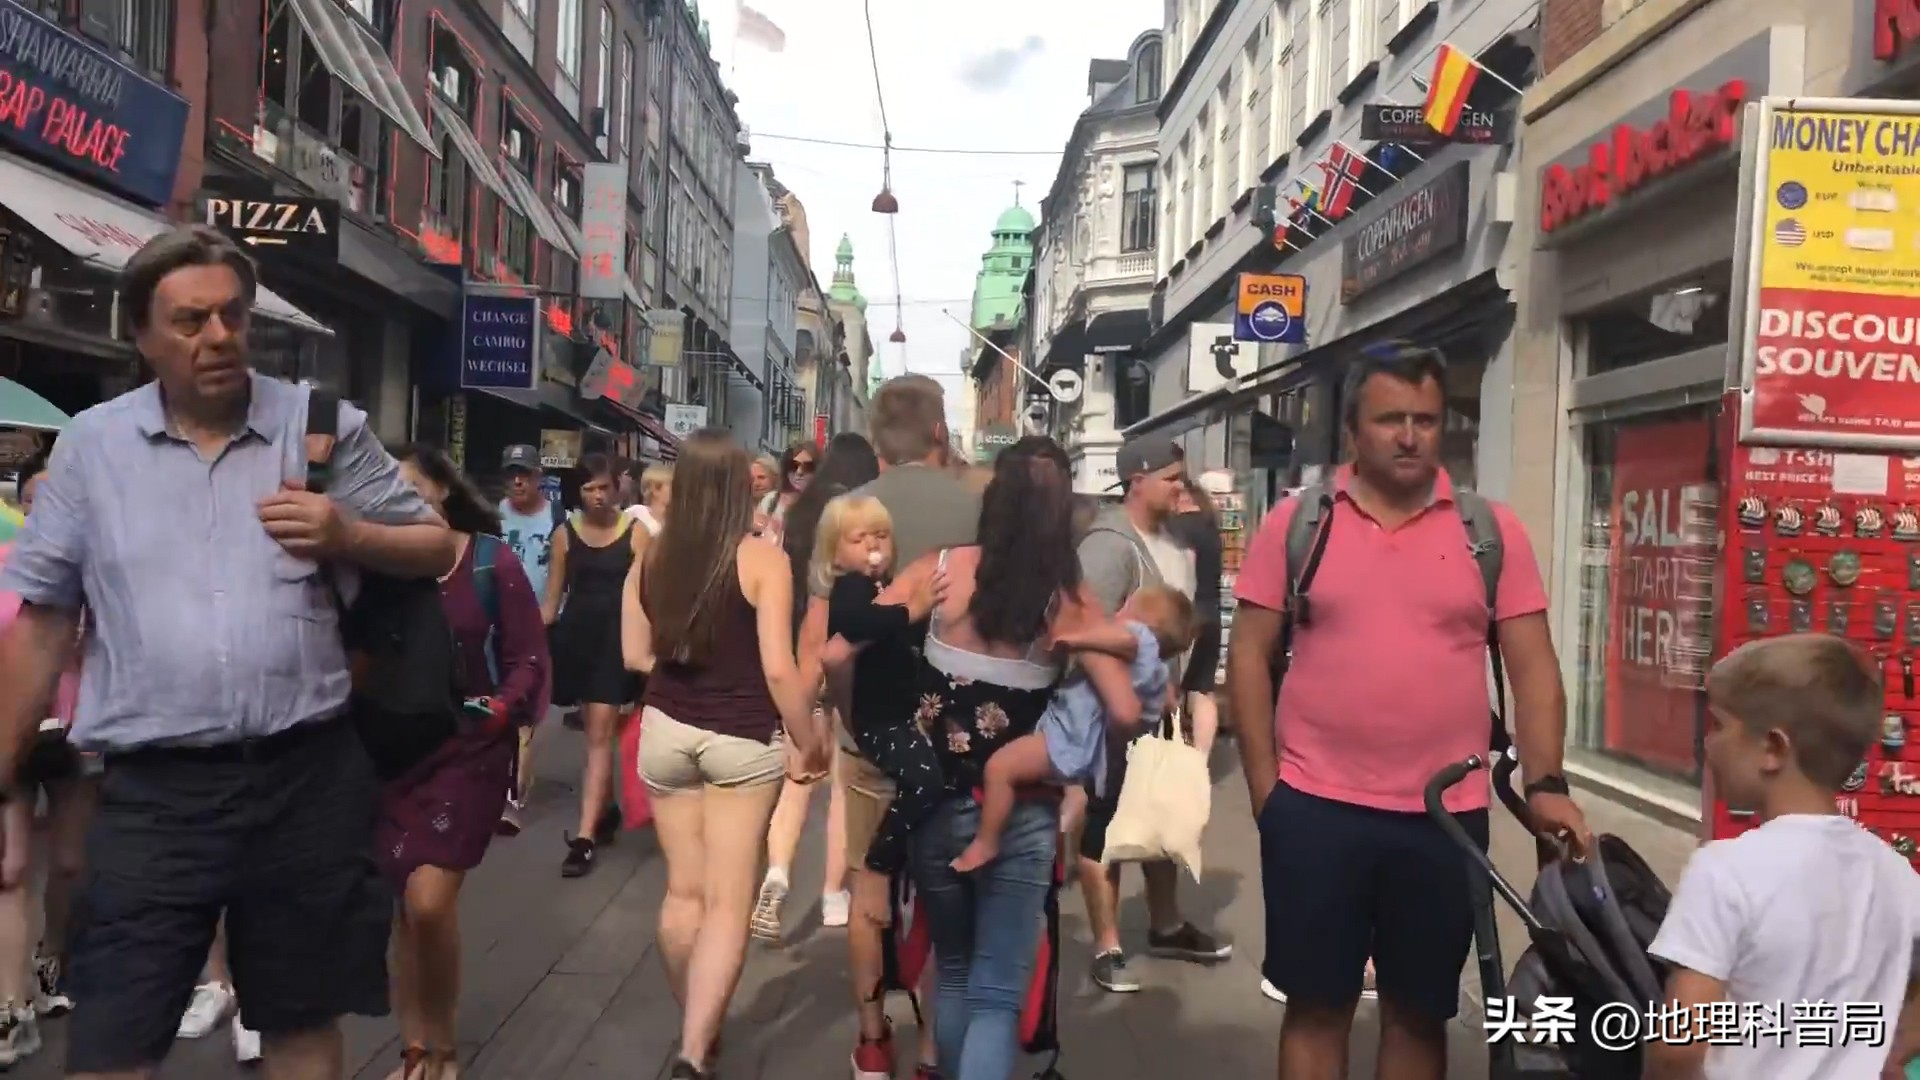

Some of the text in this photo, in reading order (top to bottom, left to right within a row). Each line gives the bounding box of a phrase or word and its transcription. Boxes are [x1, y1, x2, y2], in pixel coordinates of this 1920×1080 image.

[41, 97, 131, 173] PALACE
[1379, 108, 1494, 128] COPEGEN
[1773, 115, 1868, 154] MONEY
[207, 199, 327, 235] PIZZA
[1358, 187, 1434, 263] COPENHAGEN
[1247, 281, 1296, 299] CASH
[473, 310, 528, 325] CHANGE
[1759, 308, 1920, 346] DISCOU
[472, 334, 526, 350] CAMBIO
[467, 359, 528, 374] WECHSEL
[1756, 346, 1920, 384] SOUVEN
[1623, 486, 1700, 546] SALE
